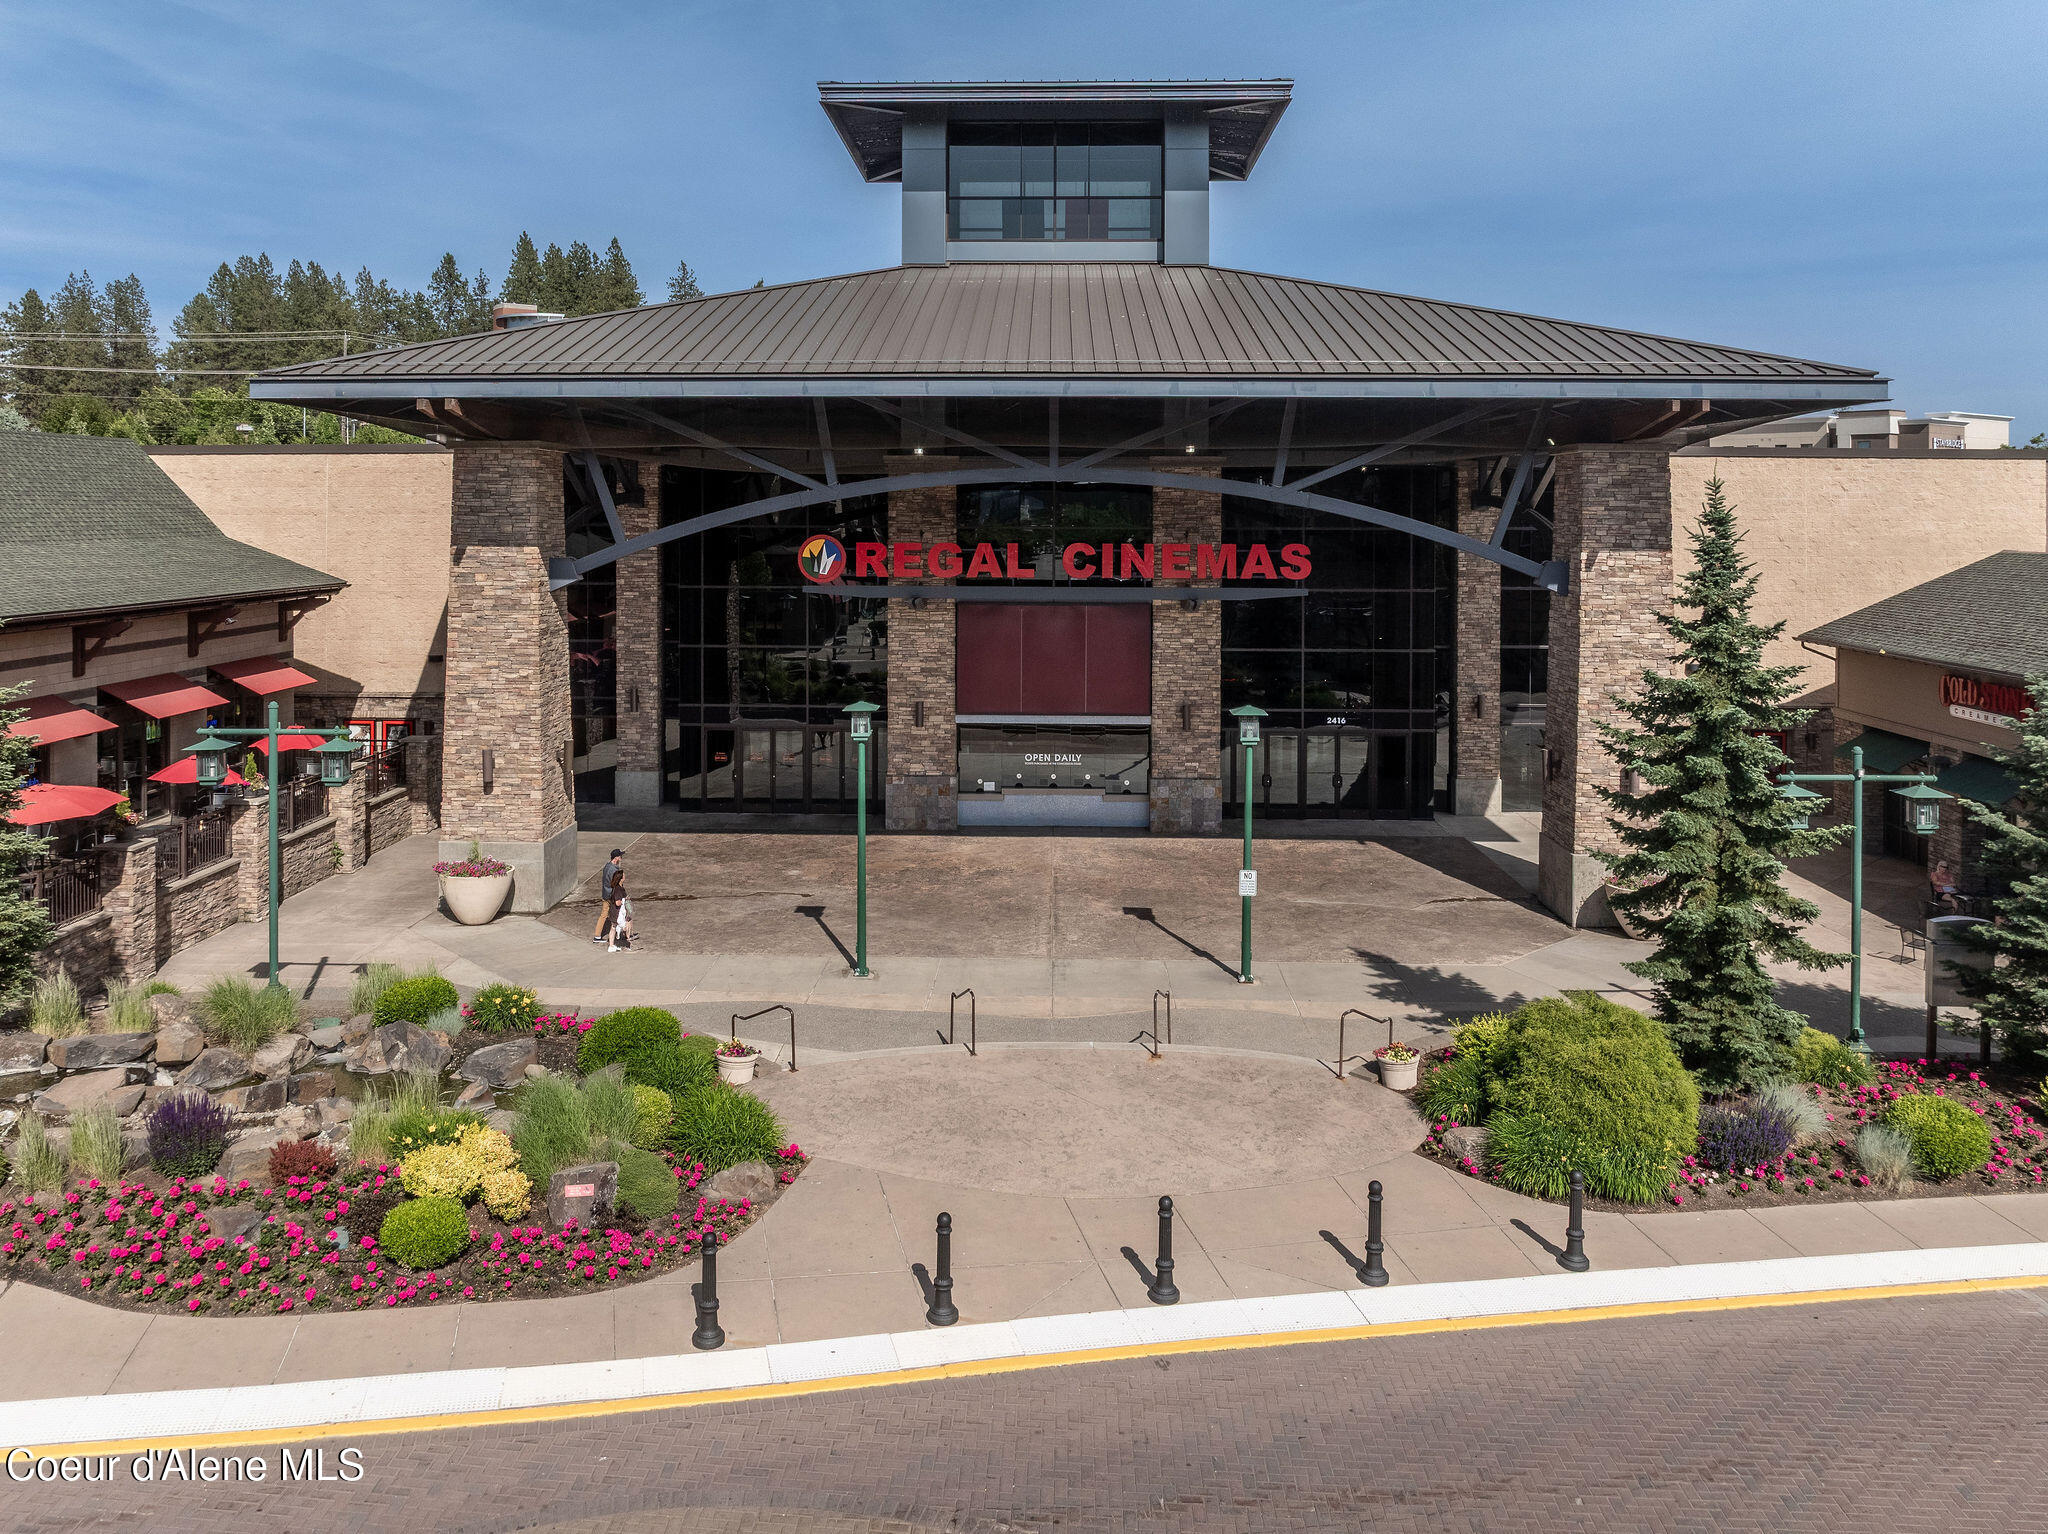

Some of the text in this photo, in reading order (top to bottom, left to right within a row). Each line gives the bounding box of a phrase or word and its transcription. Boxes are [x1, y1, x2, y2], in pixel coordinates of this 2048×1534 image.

[855, 542, 1313, 580] REGAL CINEMAS
[1939, 674, 1978, 707] COLD
[1326, 717, 1347, 725] 2416
[1954, 707, 2005, 725] CREAME
[1024, 753, 1082, 762] OPEN DAILY
[1243, 872, 1253, 880] NO
